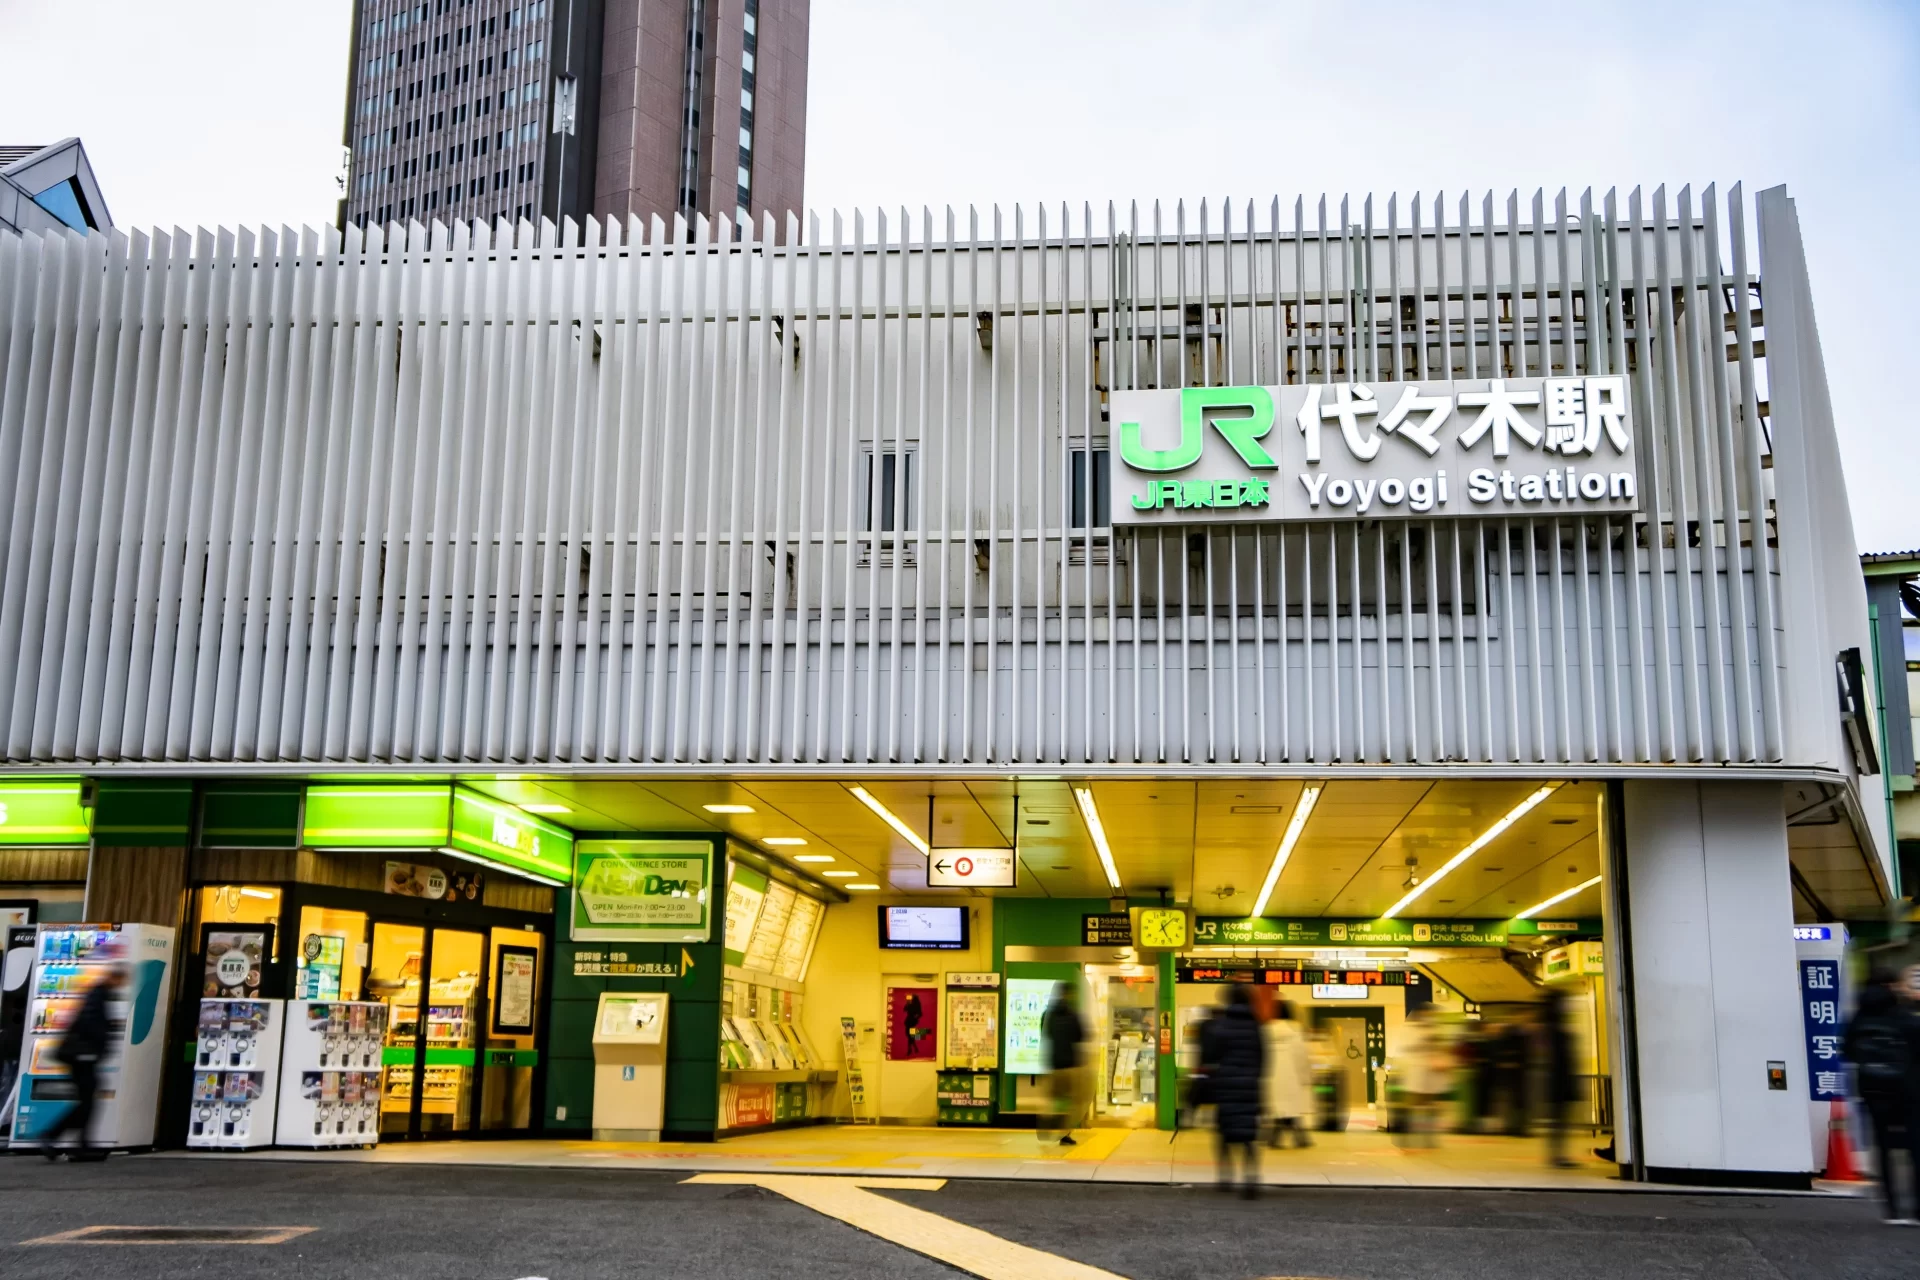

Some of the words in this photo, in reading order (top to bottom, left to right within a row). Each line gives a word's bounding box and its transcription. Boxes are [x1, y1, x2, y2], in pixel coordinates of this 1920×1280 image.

[1296, 375, 1630, 464] 代々木駅
[1120, 385, 1278, 474] JR
[1131, 476, 1270, 510] JR東日本
[1299, 470, 1448, 515] Yoyogi
[1467, 466, 1638, 504] Station
[600, 860, 660, 869] CONVENIENCE
[661, 860, 688, 869] STORE
[591, 873, 701, 897] NewDays
[591, 903, 613, 911] OPEN
[1195, 921, 1217, 936] JR
[1333, 928, 1343, 936] JY
[1417, 927, 1427, 936] JB
[14, 934, 36, 942] acur
[1222, 930, 1252, 942] Yoyogi
[1253, 931, 1284, 940] Station
[1348, 933, 1392, 942] Yamanote
[1393, 932, 1412, 942] Line
[1485, 933, 1504, 942] Line
[1806, 966, 1848, 1095] 証明写真
